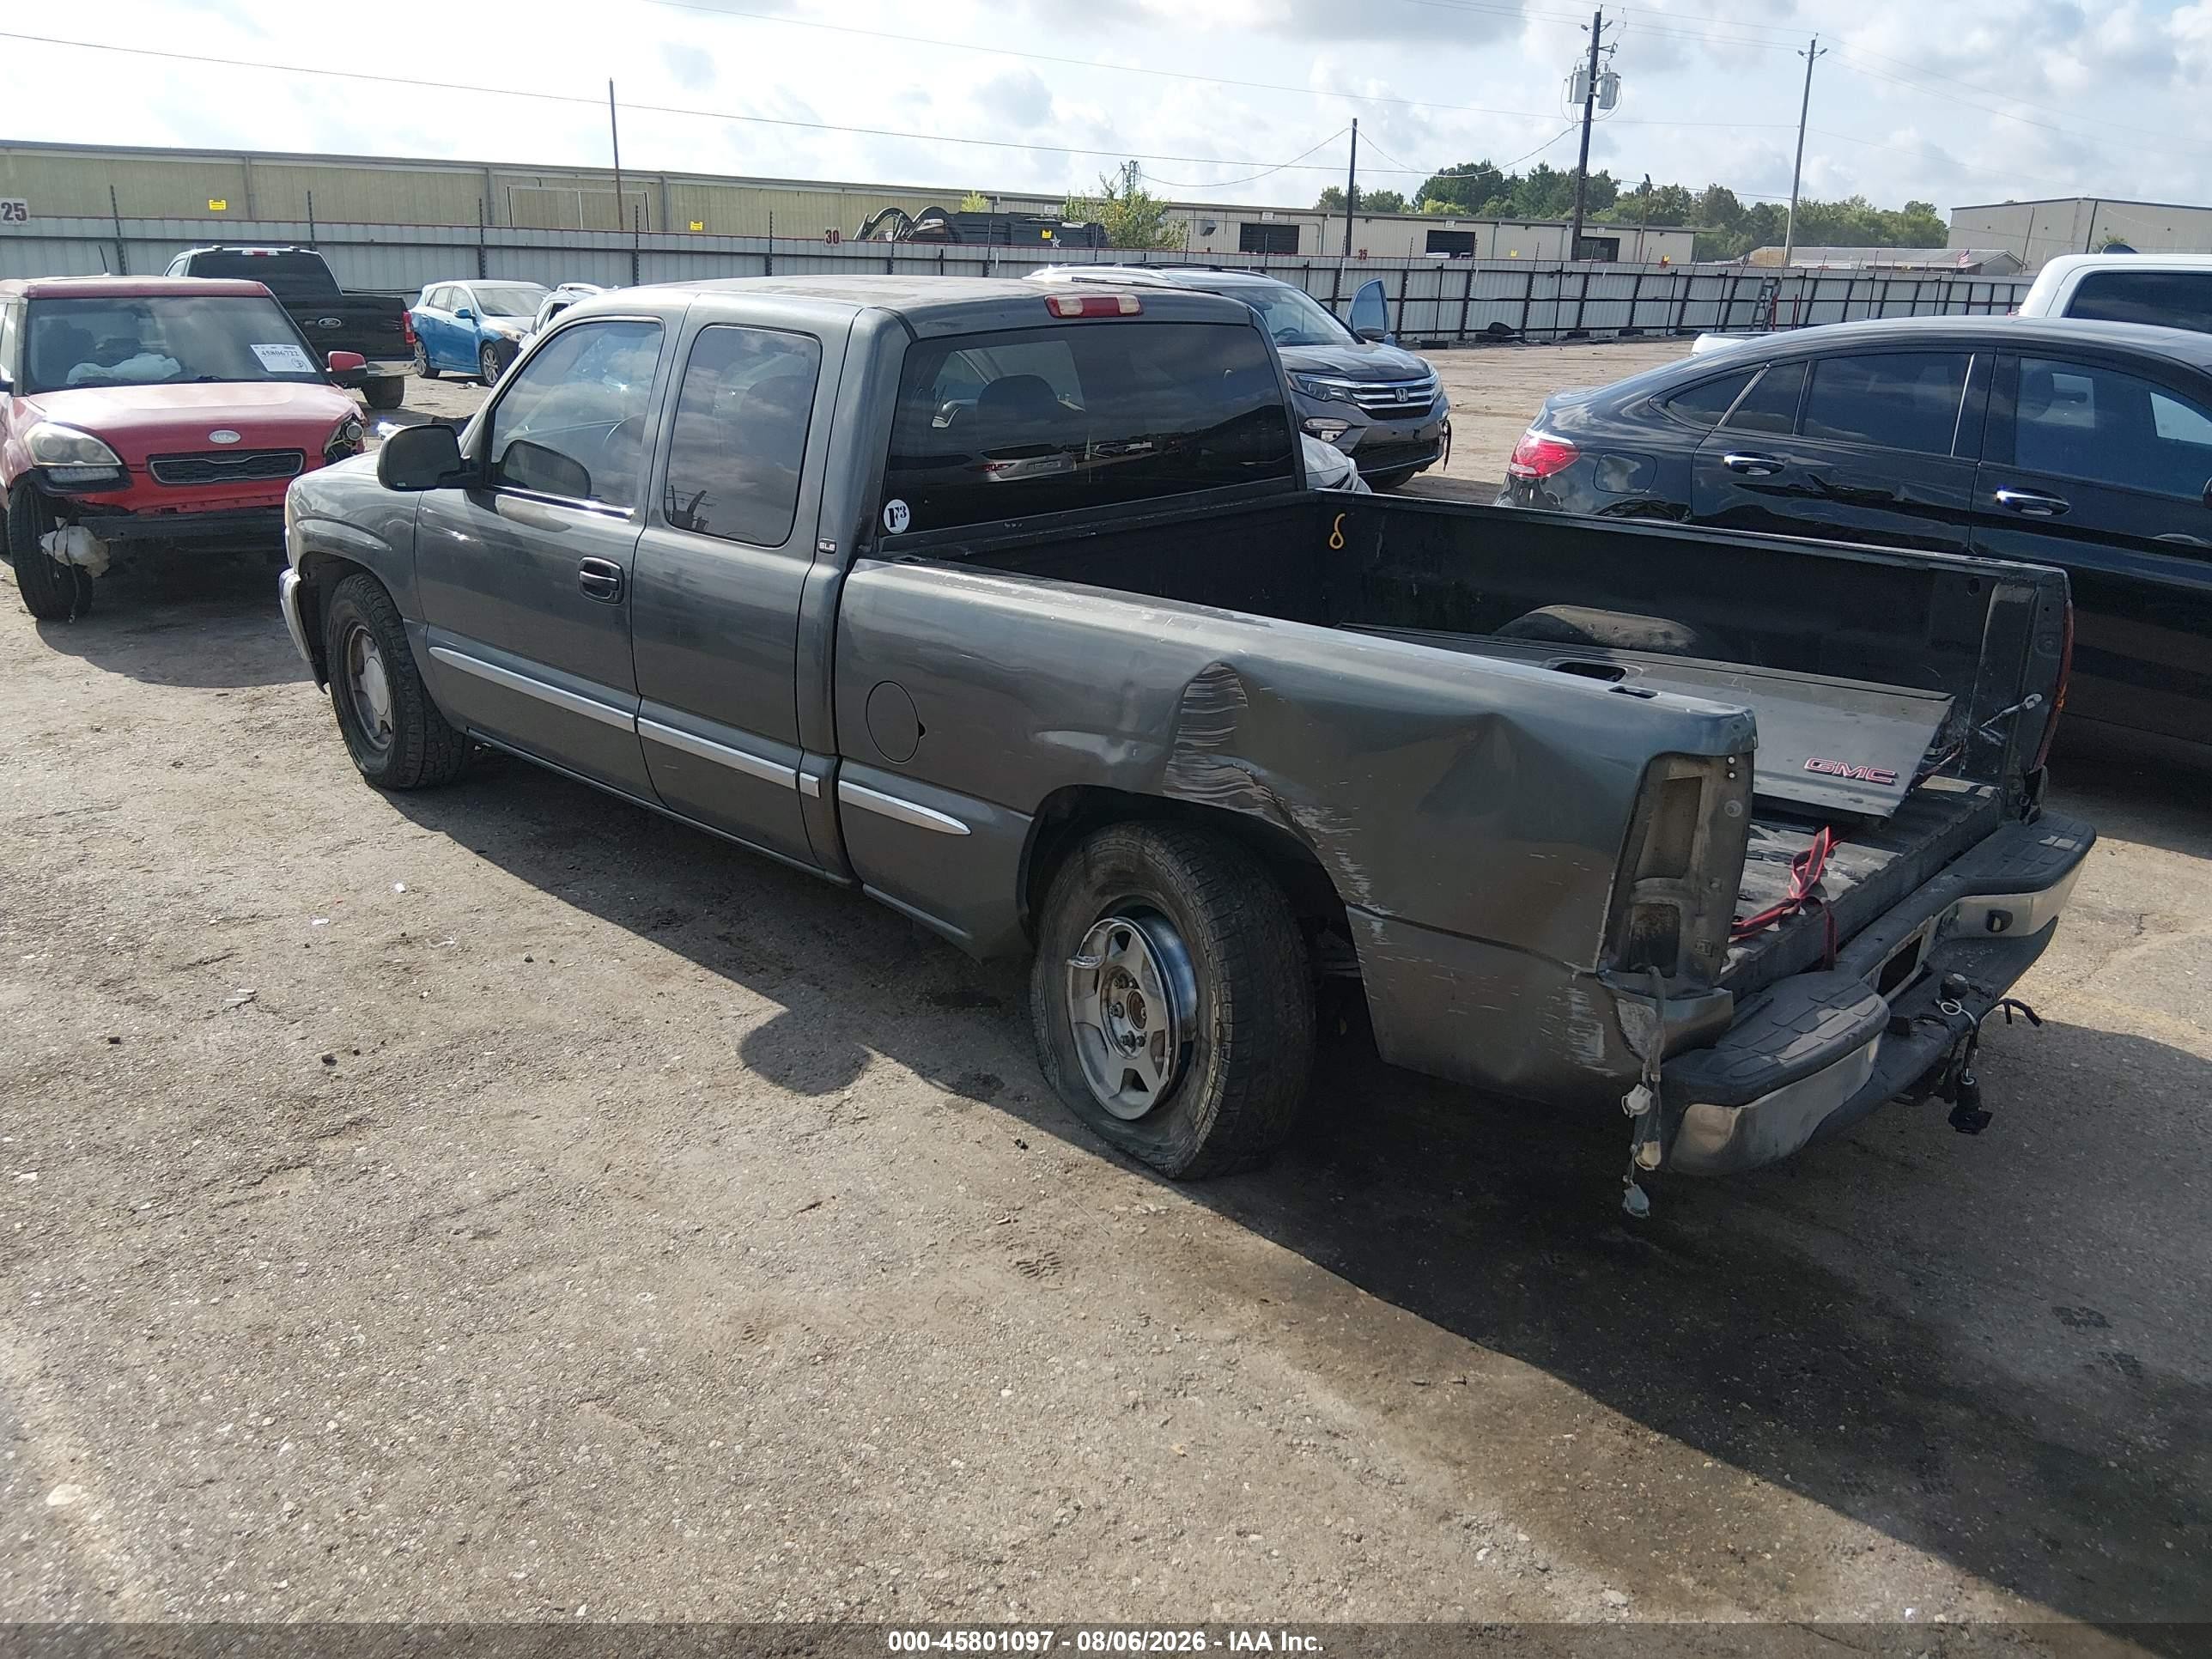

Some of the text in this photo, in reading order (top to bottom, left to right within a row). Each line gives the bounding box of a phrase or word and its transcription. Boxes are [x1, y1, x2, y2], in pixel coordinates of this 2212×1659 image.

[1, 202, 27, 222] 25
[825, 229, 840, 245] 30
[1358, 249, 1368, 260] 35
[1804, 757, 1895, 783] GMC
